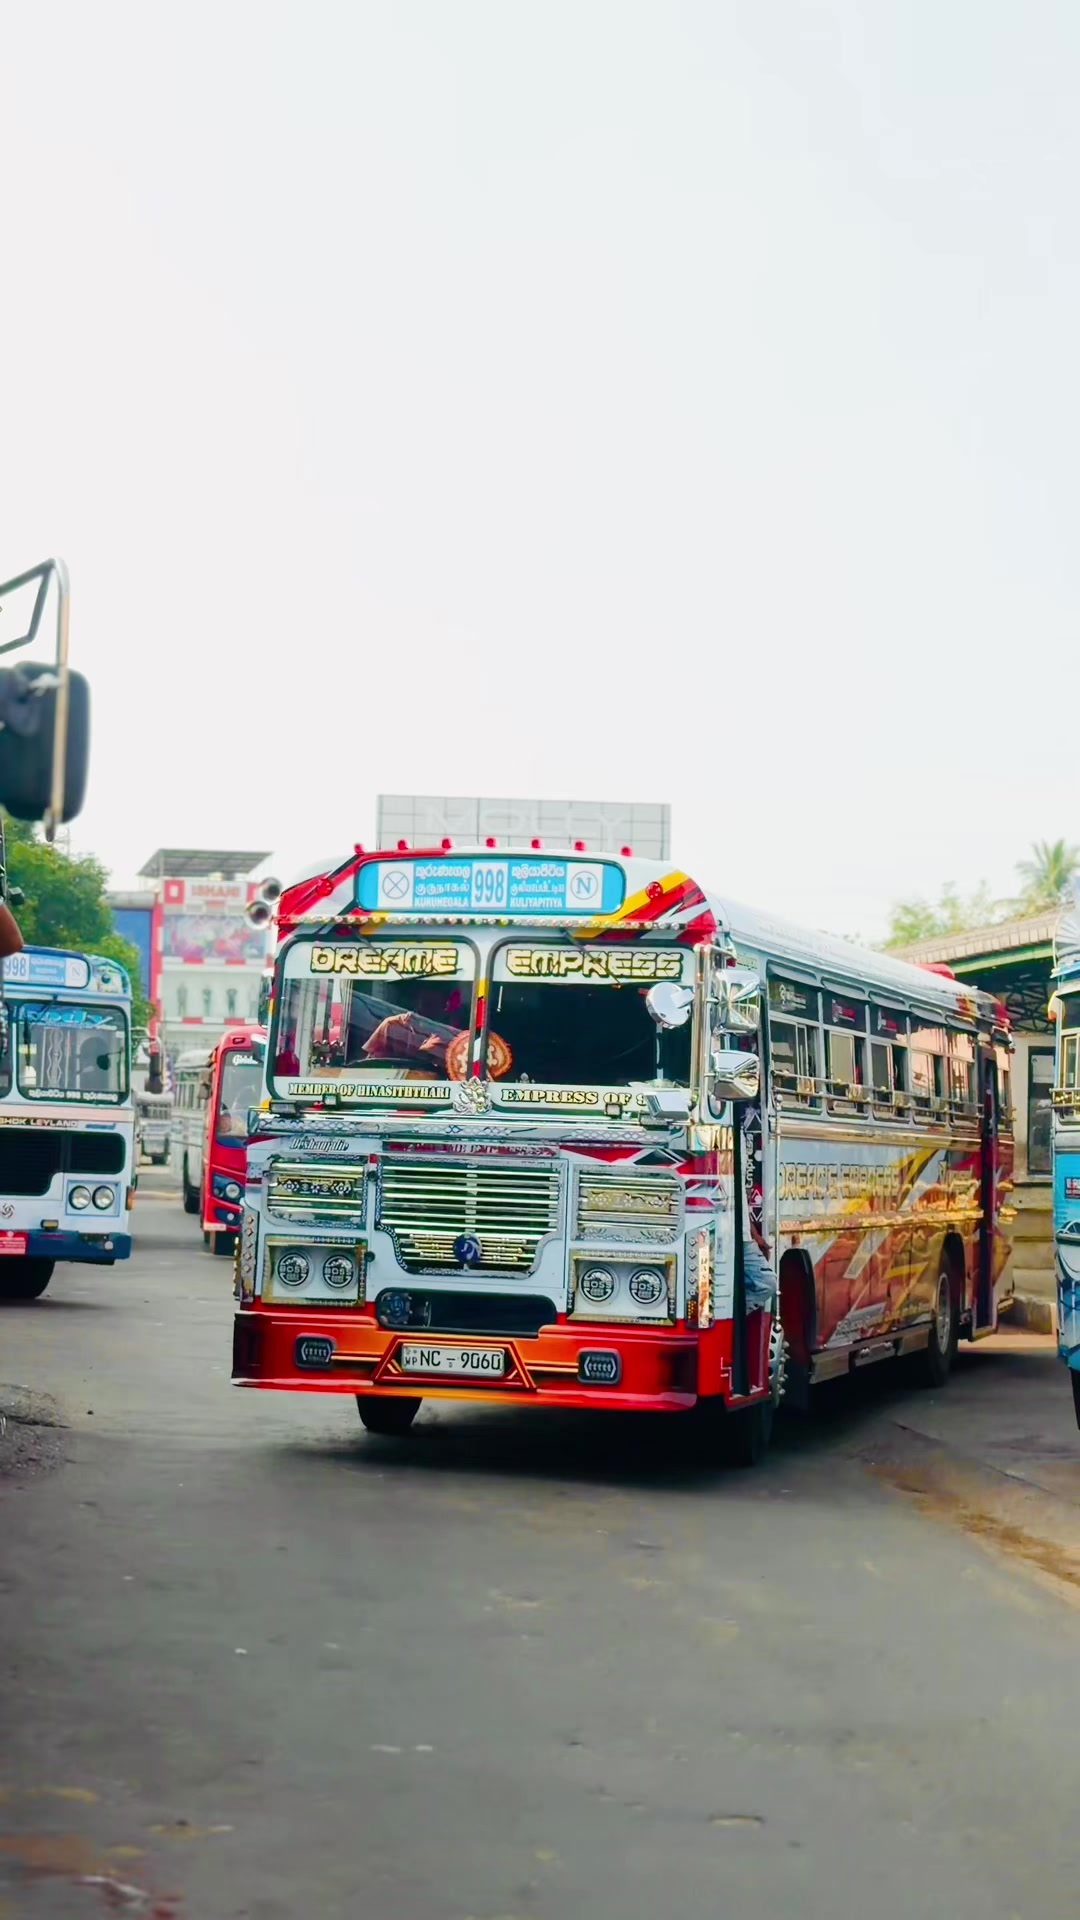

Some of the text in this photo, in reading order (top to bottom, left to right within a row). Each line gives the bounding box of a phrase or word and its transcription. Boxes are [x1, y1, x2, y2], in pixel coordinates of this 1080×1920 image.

[474, 869, 505, 903] 998
[576, 877, 592, 894] N
[310, 946, 459, 974] DREAME
[506, 949, 683, 979] EMPRESS
[289, 1083, 337, 1095] MEMBER
[338, 1085, 354, 1096] OF
[501, 1089, 598, 1104] EMPRESS
[603, 1091, 632, 1105] OF
[30, 1119, 78, 1127] LEYLAND
[583, 1279, 612, 1289] BOSS
[631, 1281, 660, 1291] BOSS
[420, 1350, 441, 1366] NC
[460, 1352, 500, 1370] 9060
